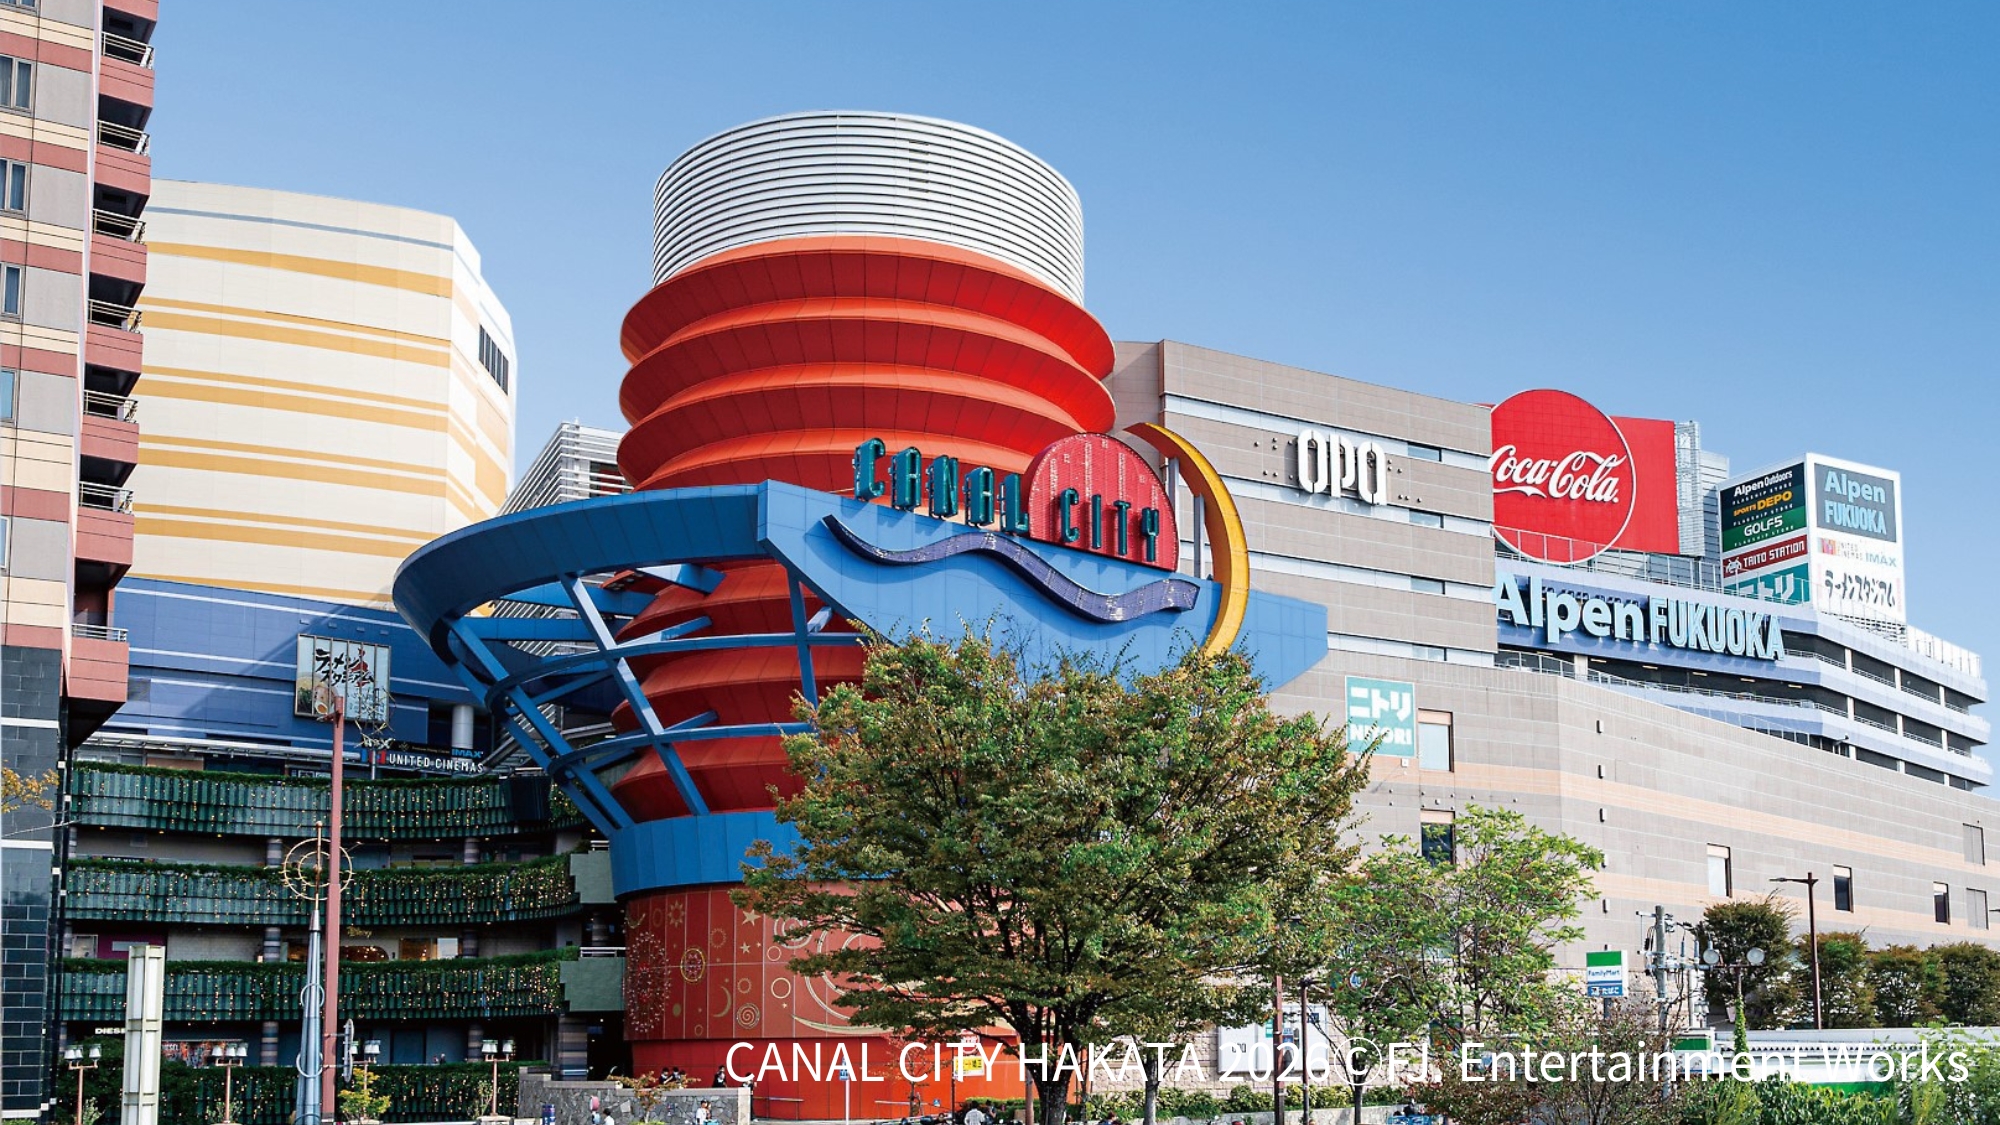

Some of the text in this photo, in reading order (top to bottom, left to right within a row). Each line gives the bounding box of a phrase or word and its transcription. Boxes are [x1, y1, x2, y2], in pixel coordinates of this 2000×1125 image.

[1298, 429, 1387, 506] OPA
[1489, 444, 1626, 502] Coca-Cola
[1732, 482, 1792, 505] FLAGSHIP STORE
[1734, 471, 1793, 497] Alpen Outdoors
[1824, 470, 1886, 504] Alpen
[854, 438, 1159, 562] CANAL CITY
[1733, 490, 1793, 516] SPORTS DEPO
[1733, 503, 1793, 526] FLAGSHIP STORE
[1744, 515, 1783, 537] GOLF5
[1824, 500, 1887, 535] FUKUOKA
[1734, 525, 1794, 547] FLAGSHIP STORE
[1743, 541, 1805, 568] TAITO STATION
[1865, 552, 1897, 567] IMAX
[1491, 572, 1785, 660] Alpen FUKUOKA
[1349, 686, 1411, 722] ニトリ
[1349, 724, 1412, 745] NITORI
[389, 753, 484, 773] UNITED CINEMAS
[452, 748, 483, 758] IMAX
